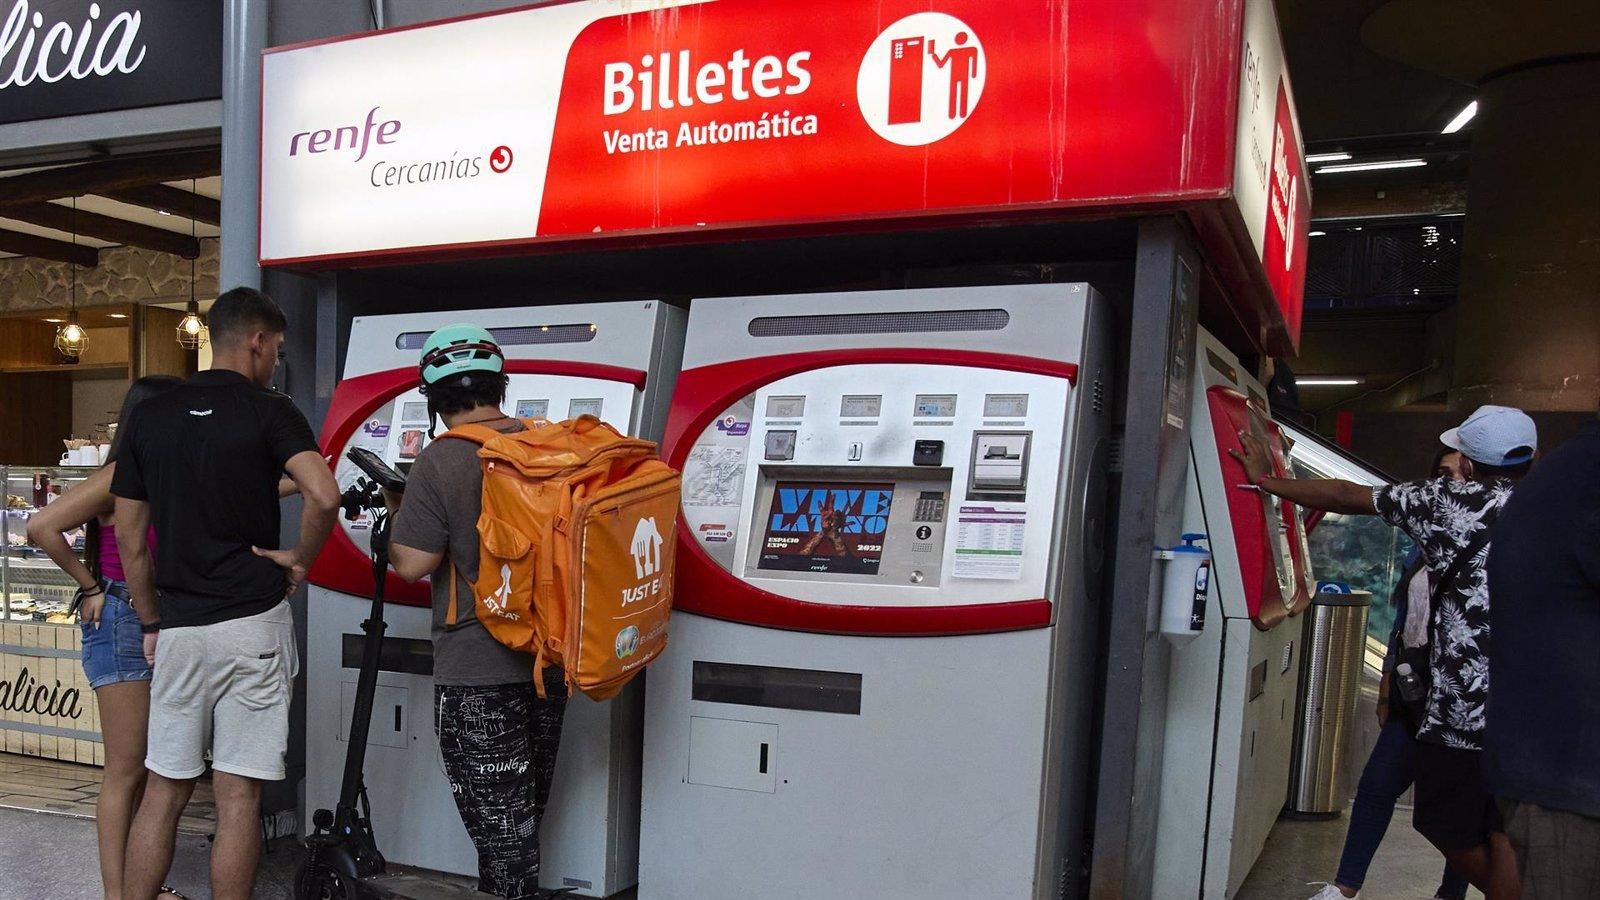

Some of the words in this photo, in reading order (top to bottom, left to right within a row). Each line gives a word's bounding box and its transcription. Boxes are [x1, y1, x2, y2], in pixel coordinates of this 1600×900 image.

[603, 48, 811, 116] Billetes
[289, 105, 401, 163] renfe
[603, 127, 669, 154] Venta
[675, 109, 818, 148] Automática
[370, 151, 482, 188] Cercanías
[779, 488, 893, 516] VIVE
[770, 513, 888, 534] LATNO
[856, 544, 882, 552] 2022
[621, 583, 650, 608] JUST
